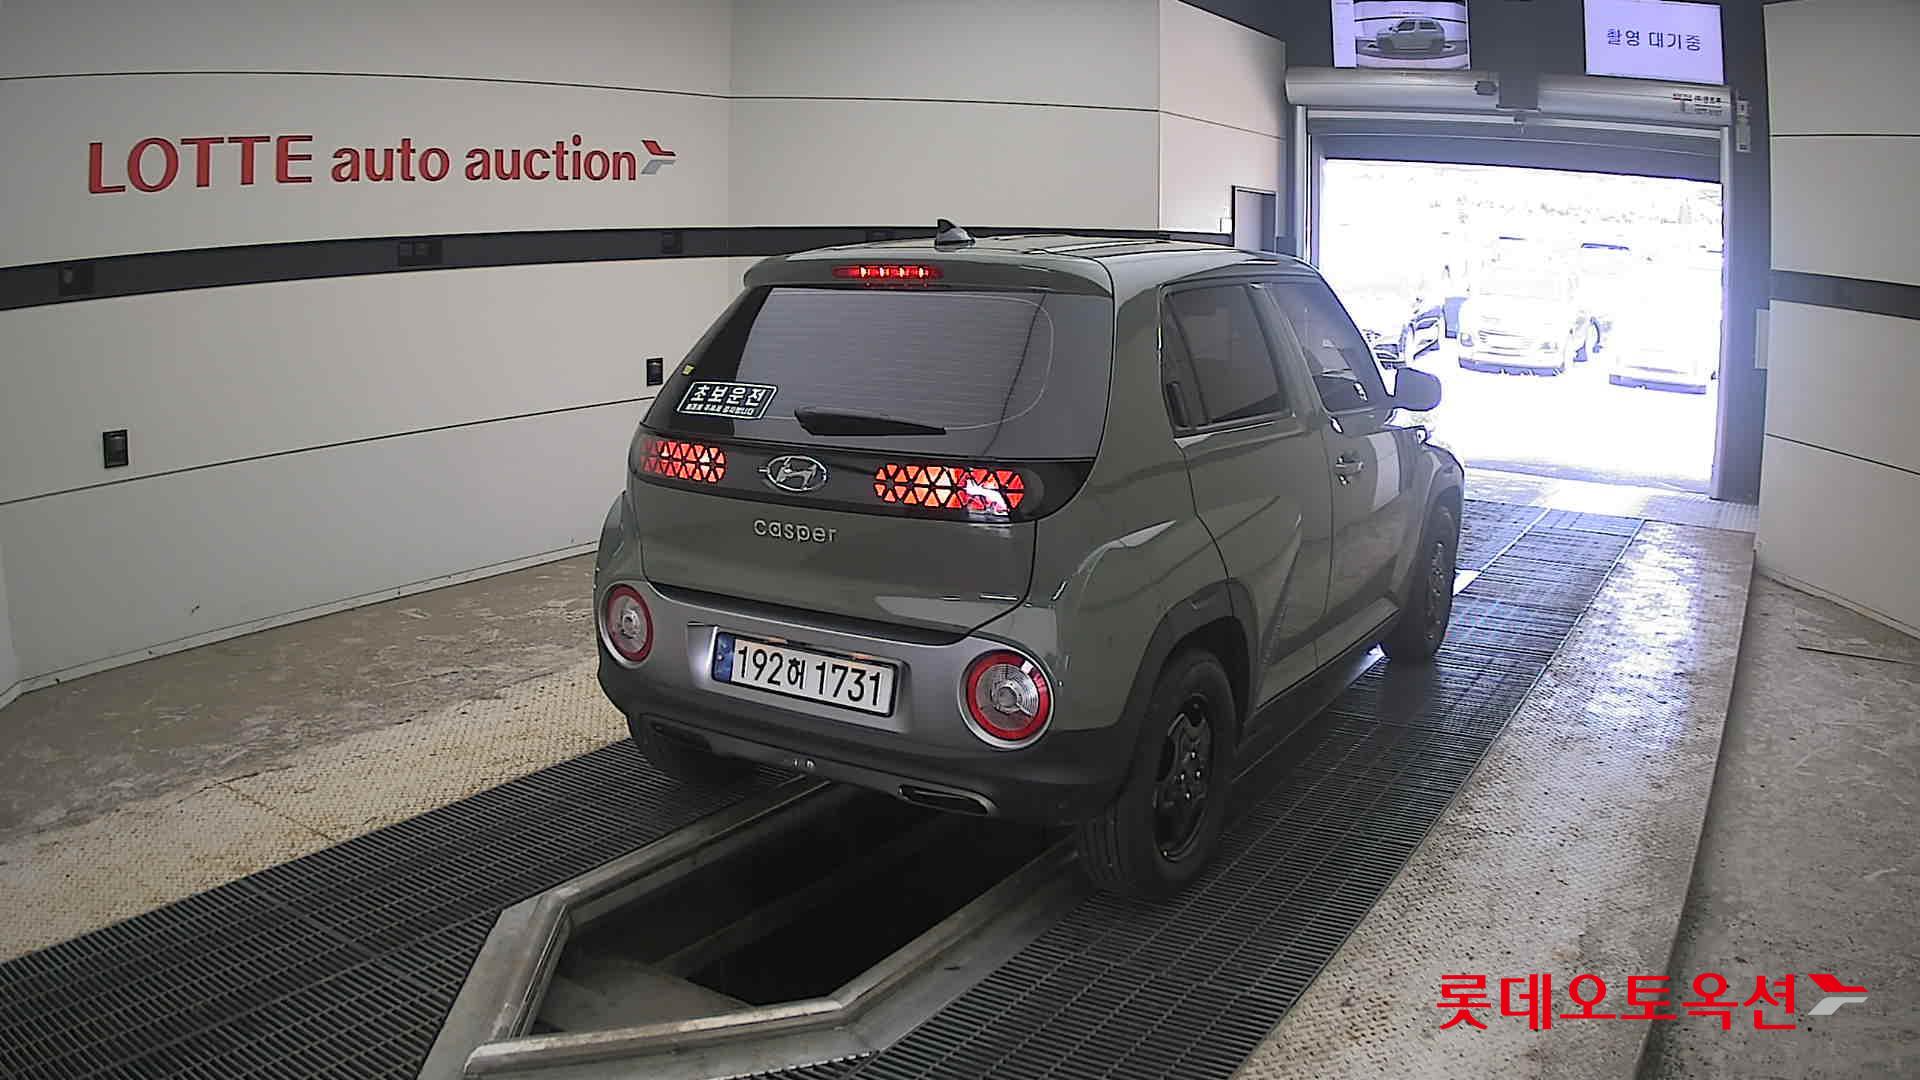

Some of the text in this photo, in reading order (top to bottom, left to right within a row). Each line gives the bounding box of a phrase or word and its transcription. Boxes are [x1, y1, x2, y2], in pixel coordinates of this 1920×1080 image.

[1607, 28, 1701, 52] 촬영 대기중
[89, 134, 638, 193] LOTTE auto auction
[690, 385, 767, 406] 초보운전
[754, 519, 837, 542] casper
[738, 646, 882, 706] 192허 1731
